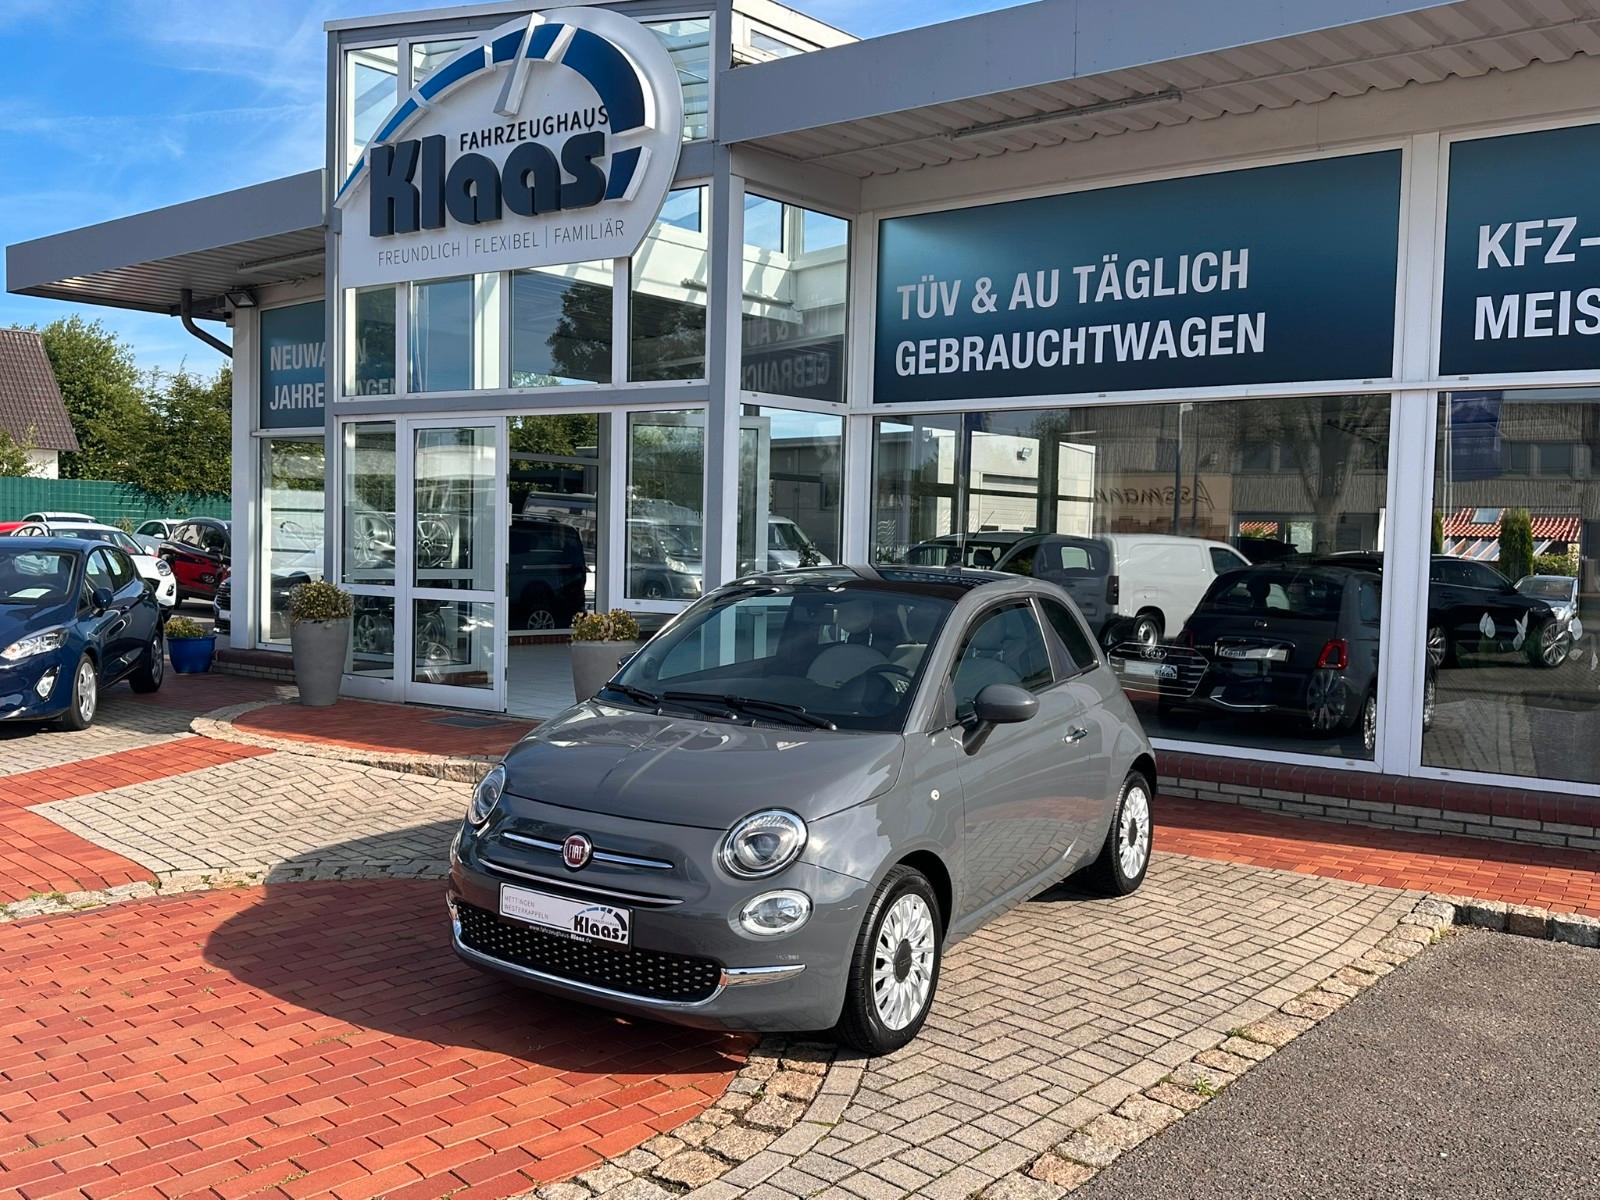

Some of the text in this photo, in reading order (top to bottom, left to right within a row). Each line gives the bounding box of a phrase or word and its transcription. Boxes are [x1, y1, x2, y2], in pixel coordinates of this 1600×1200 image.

[460, 105, 608, 152] FAHRZEUGHAUS
[369, 131, 607, 238] Klaas
[378, 218, 625, 267] FREUNDLICH FLEXIBEL FAMILIÄR
[1477, 216, 1600, 270] KFZ-
[896, 247, 1250, 321] TÜV & AU TÄGLICH
[1474, 287, 1600, 341] MEIS
[895, 311, 1266, 377] GEBRAUCHTWAGEN
[568, 844, 584, 860] FIAT
[574, 915, 620, 940] Klaas
